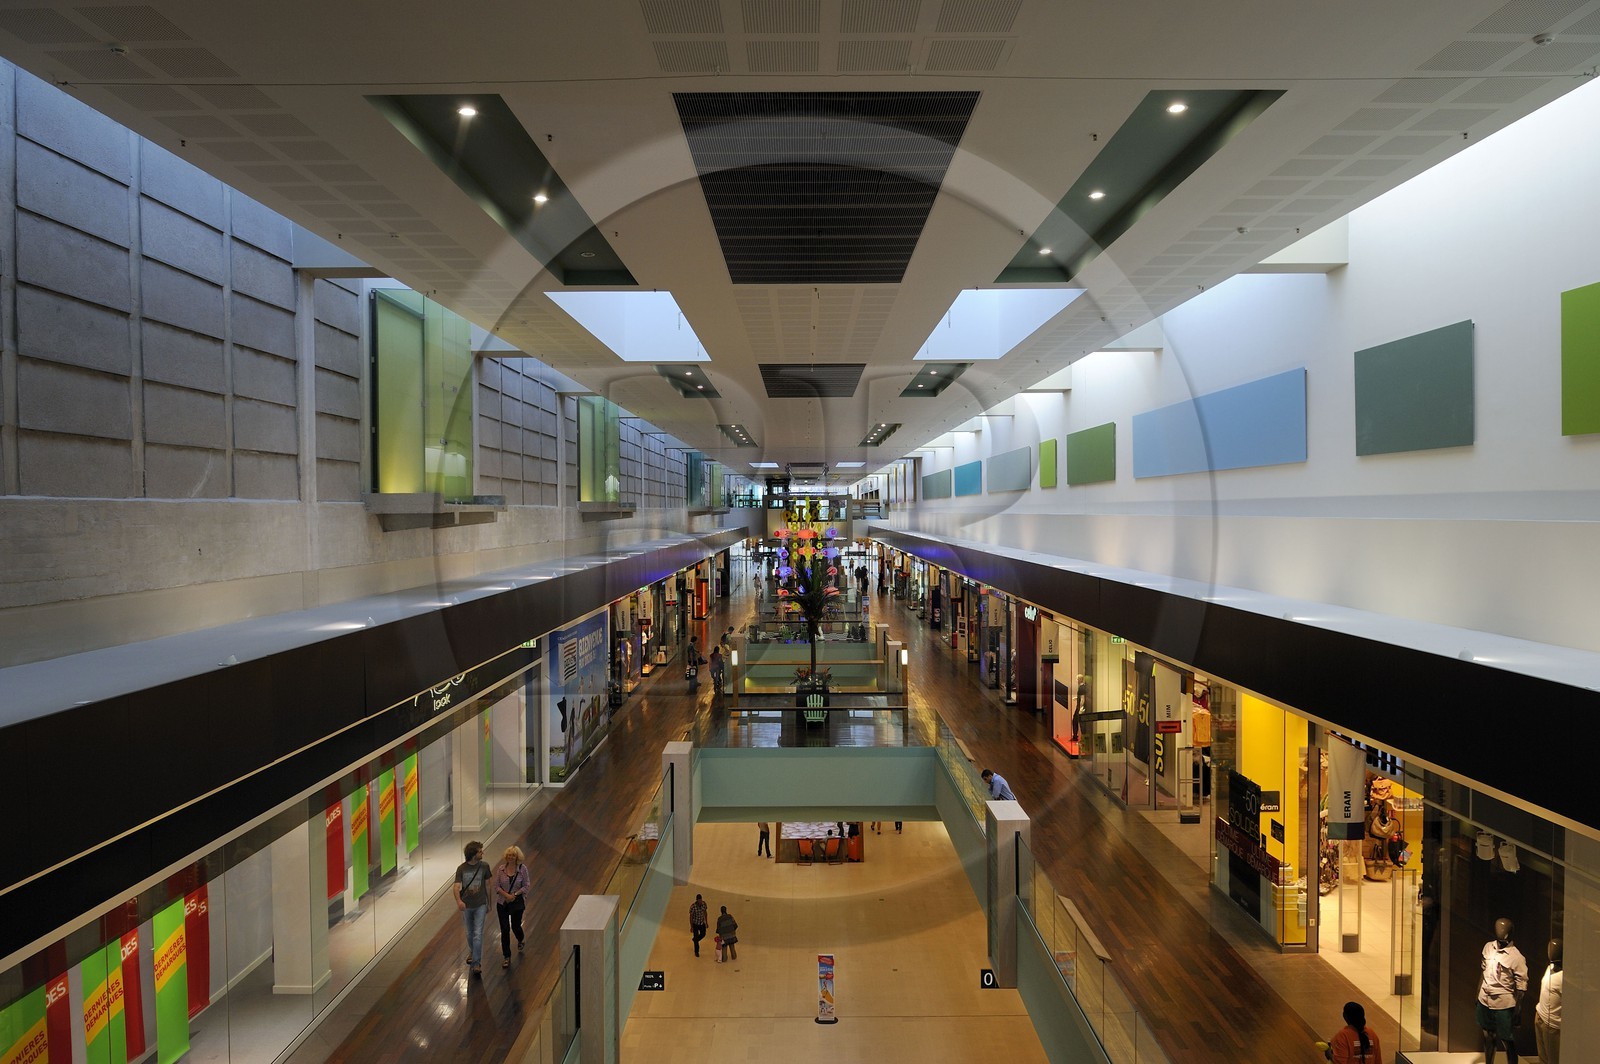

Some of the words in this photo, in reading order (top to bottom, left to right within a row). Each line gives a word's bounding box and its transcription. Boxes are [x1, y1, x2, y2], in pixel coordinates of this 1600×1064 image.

[433, 693, 450, 711] look
[1260, 803, 1279, 811] éram
[1344, 790, 1352, 819] ERAM
[1229, 806, 1260, 841] SOLDES
[121, 936, 138, 962] DES
[153, 934, 184, 972] DERNIERES
[984, 972, 993, 986] 0
[83, 978, 121, 1022] DERNIERES
[85, 987, 124, 1033] DEMARQUES
